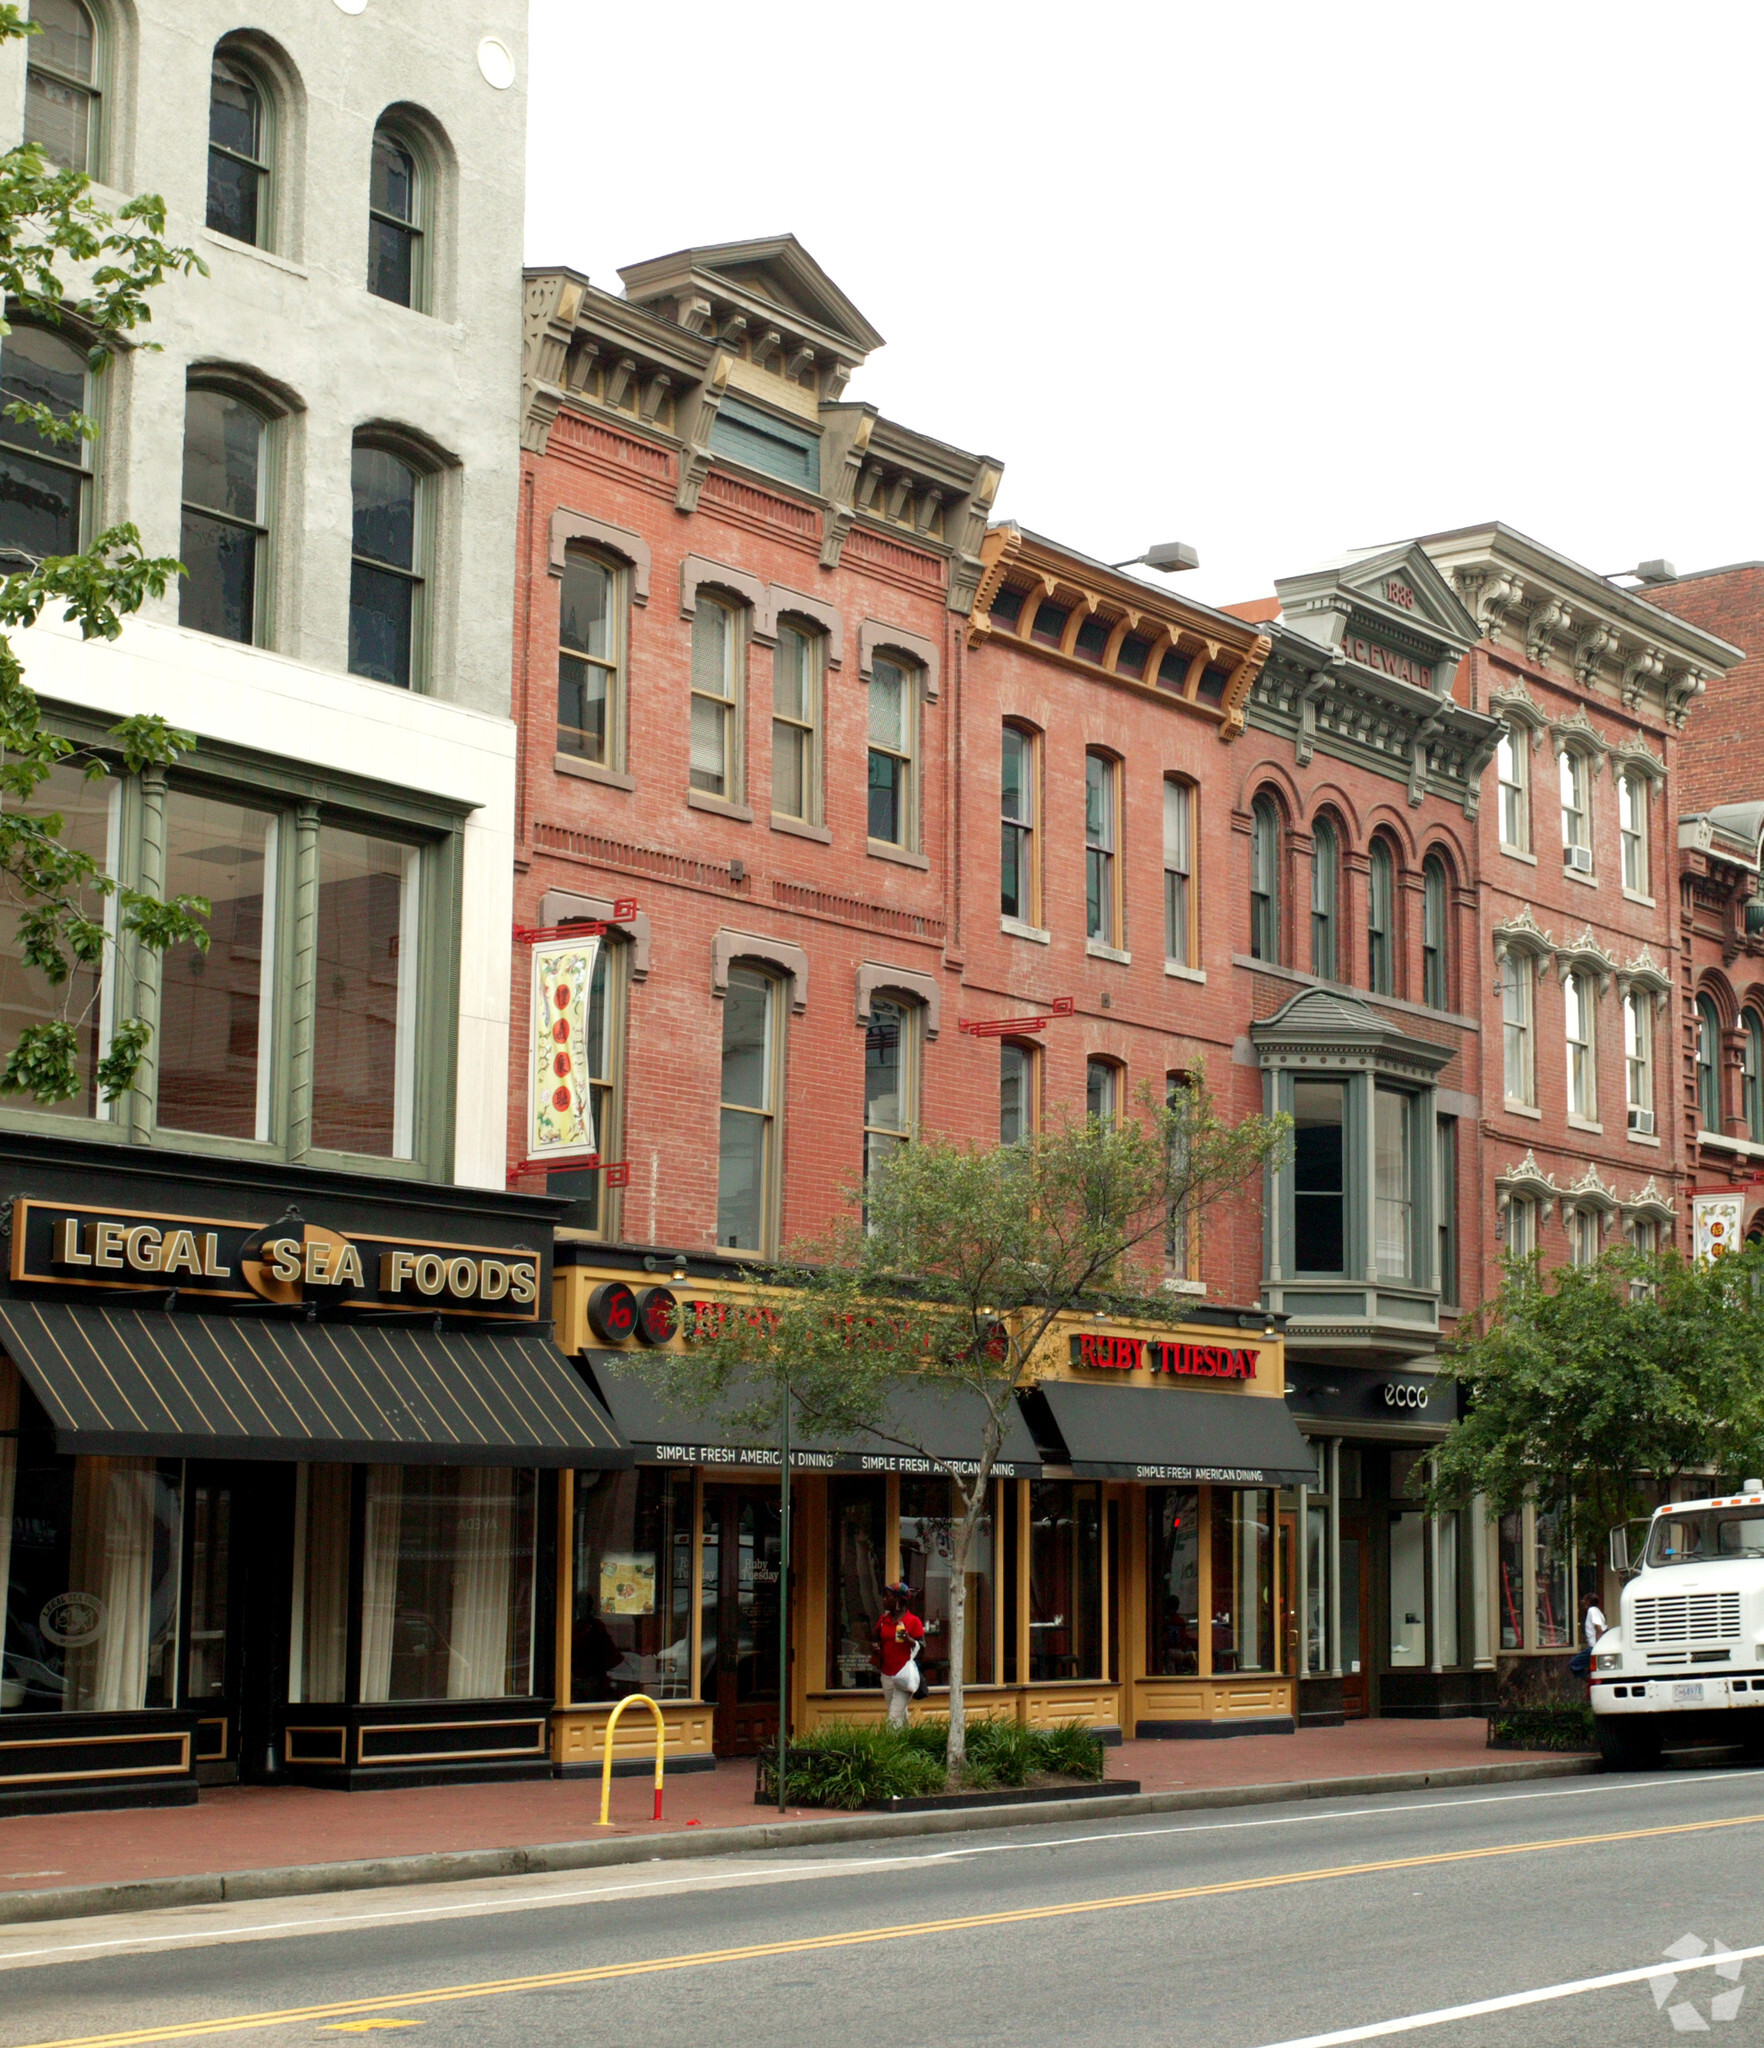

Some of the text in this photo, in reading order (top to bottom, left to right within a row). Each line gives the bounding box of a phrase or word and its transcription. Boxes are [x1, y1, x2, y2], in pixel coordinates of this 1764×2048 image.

[1388, 579, 1414, 609] 1888
[62, 1218, 537, 1304] LEGAL SEA FOODS
[1079, 1333, 1261, 1380] RUBY TUESDAY
[1384, 1383, 1429, 1409] ecco
[656, 1445, 834, 1468] SIMPLE FRESH AMERICN DINING
[861, 1456, 896, 1471] SIMPLE
[899, 1457, 930, 1472] FRESH
[1136, 1465, 1263, 1482] SIMPLE FRESH AMERICAN DINING
[742, 1569, 780, 1583] Tuesday
[744, 1558, 768, 1571] Ruby
[42, 1595, 66, 1618] LEGAL
